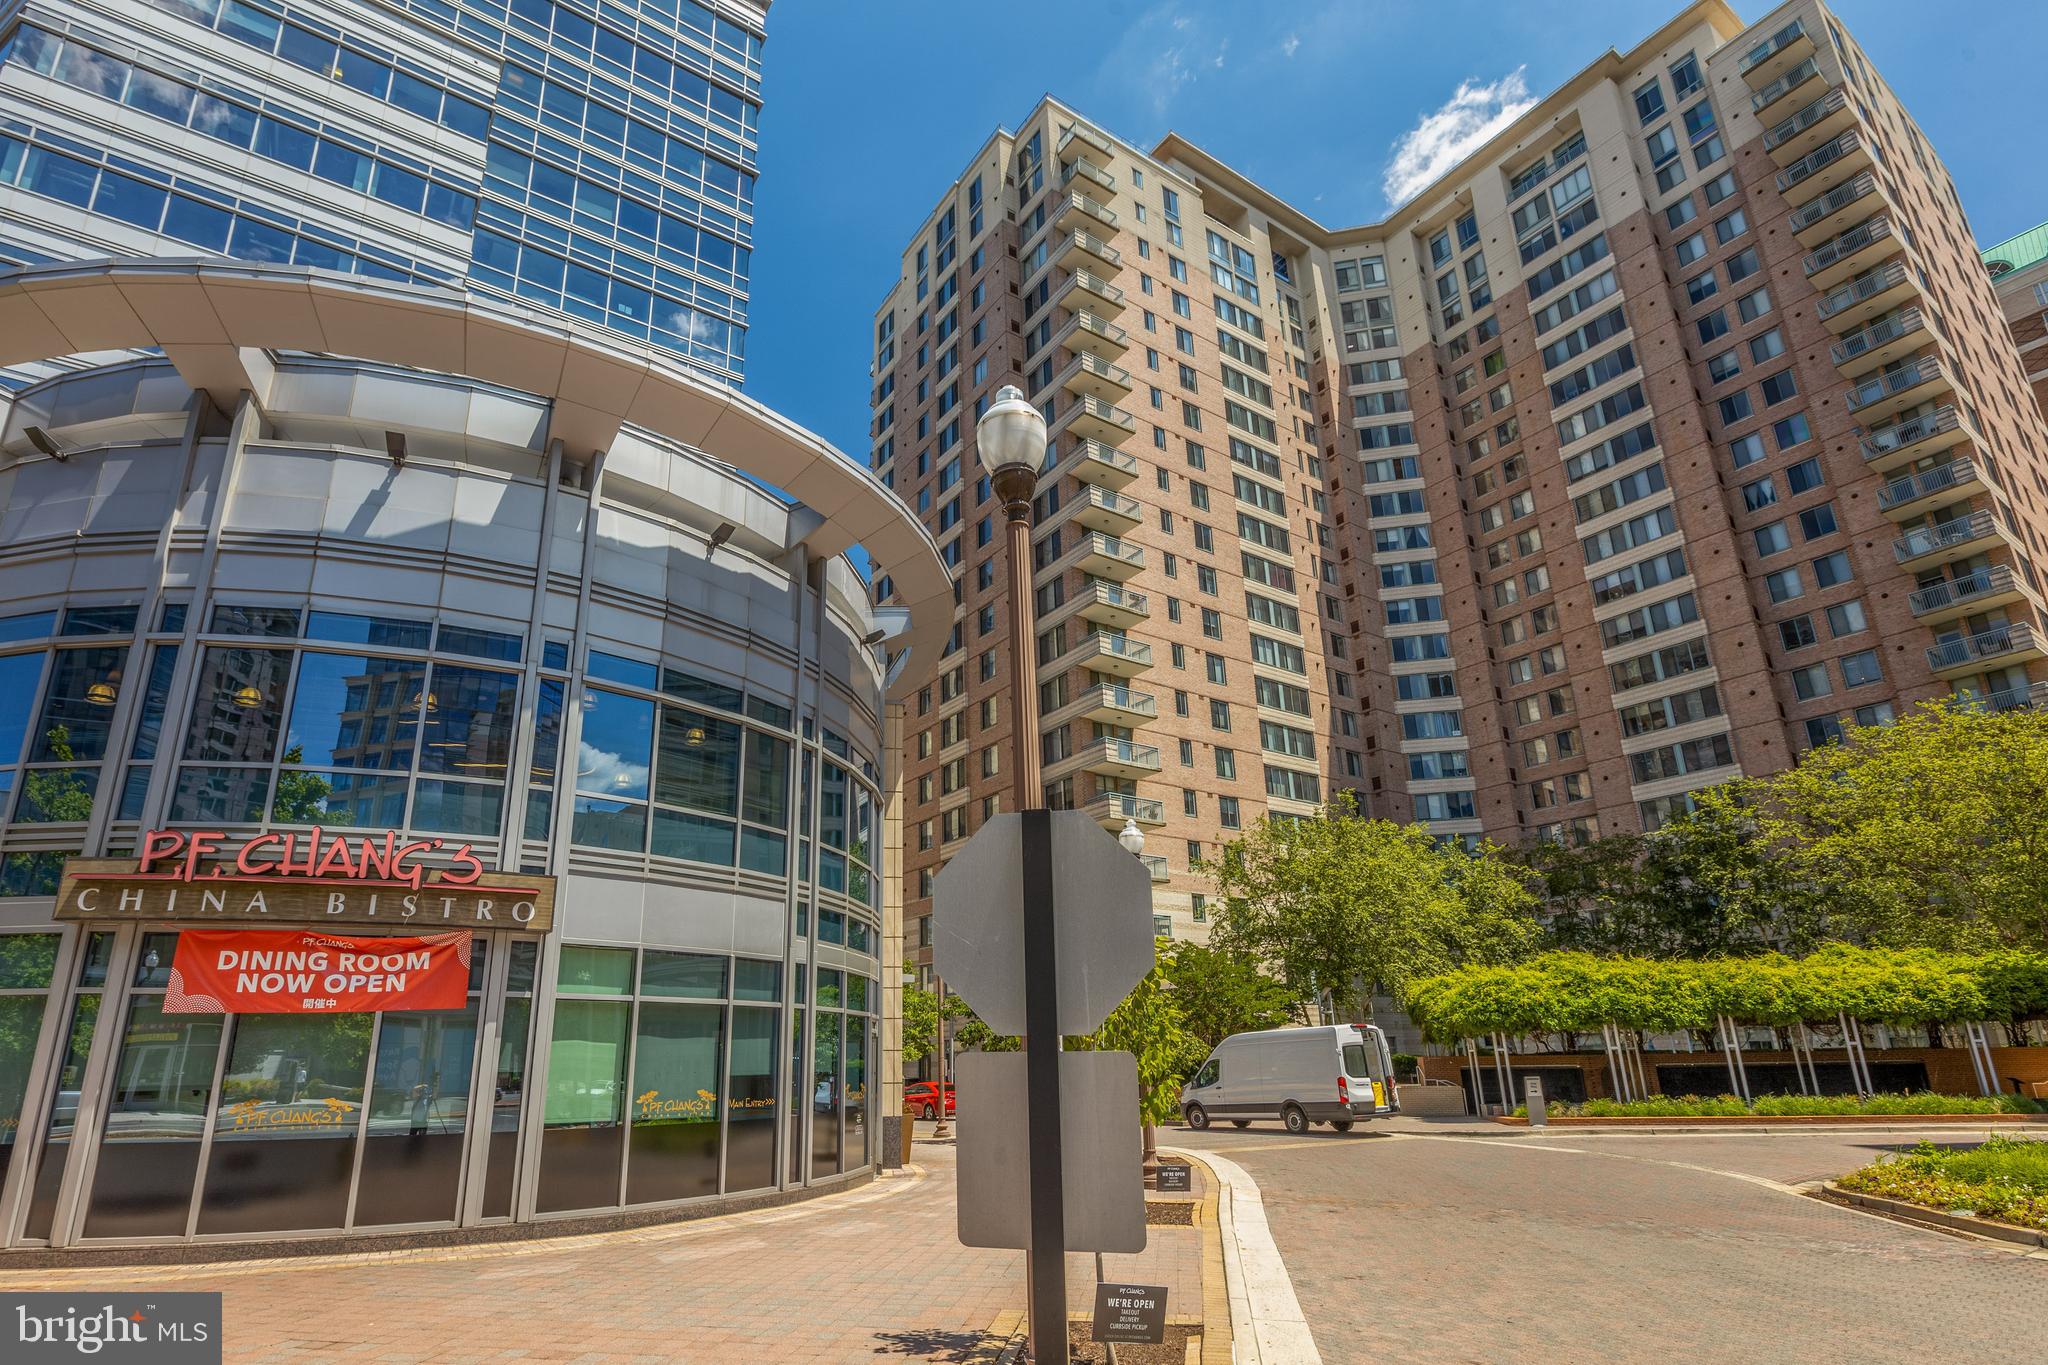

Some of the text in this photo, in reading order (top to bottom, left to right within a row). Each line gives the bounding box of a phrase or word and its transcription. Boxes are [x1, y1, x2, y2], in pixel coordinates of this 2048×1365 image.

[139, 825, 483, 890] P.F. CHANG'S
[77, 888, 536, 922] CHINA BISTRO
[217, 950, 431, 972] DINING ROOM
[236, 973, 406, 993] NOW OPEN
[1107, 1297, 1155, 1310] WE'RE OPEN
